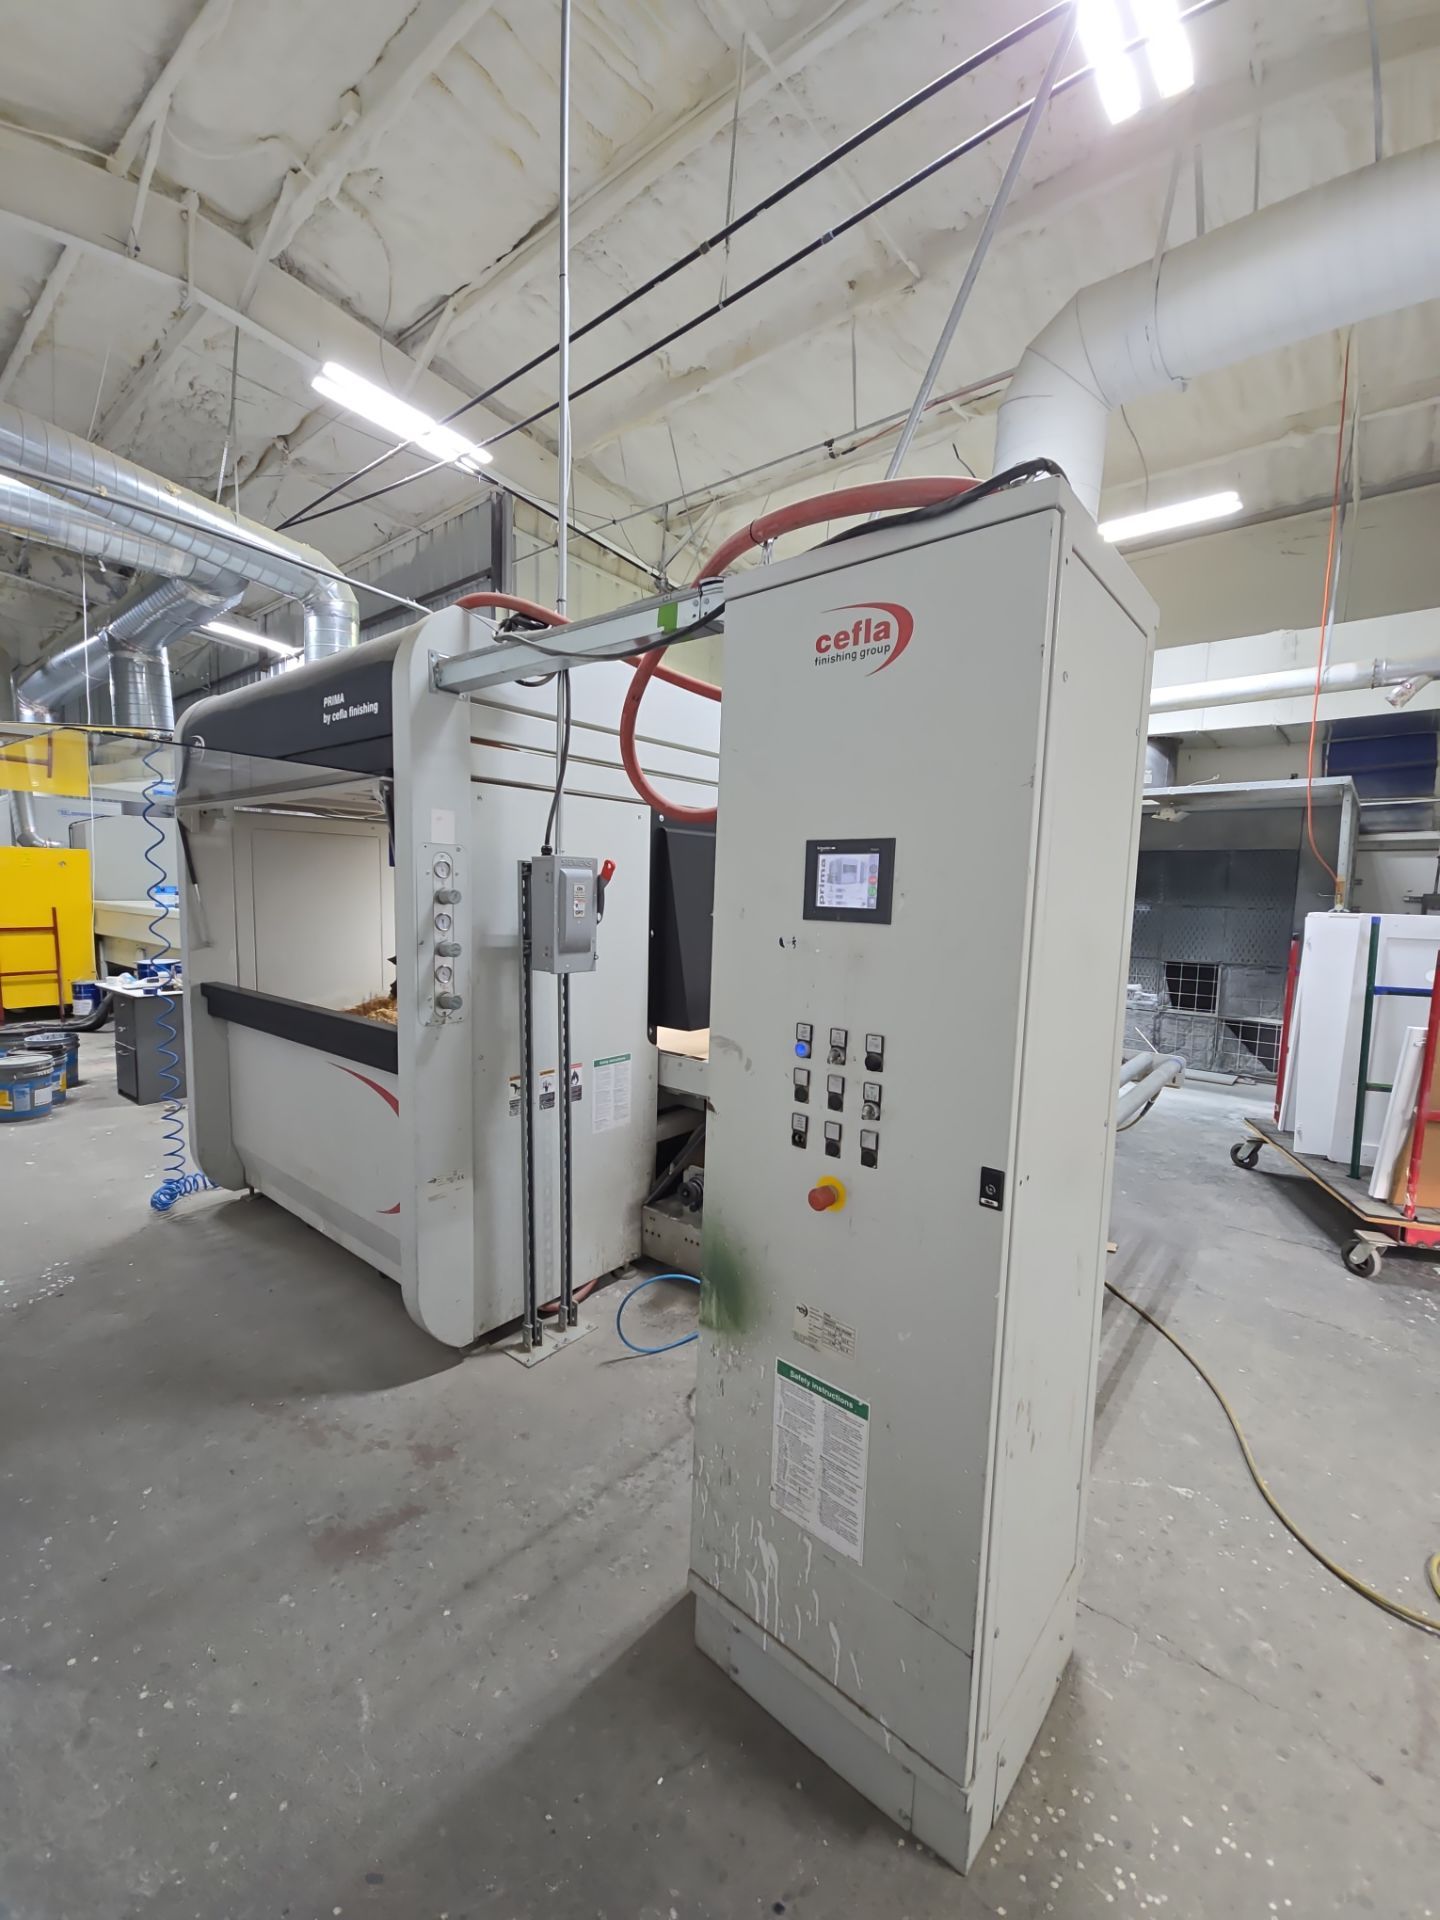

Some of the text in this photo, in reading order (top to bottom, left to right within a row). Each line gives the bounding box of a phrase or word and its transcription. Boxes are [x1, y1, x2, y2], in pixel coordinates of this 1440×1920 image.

[815, 618, 891, 654] cefla
[814, 644, 891, 667] finishing group
[323, 692, 344, 708] PRIMA
[322, 701, 378, 725] by cefla finishing
[789, 1369, 854, 1409] Safety instructions
